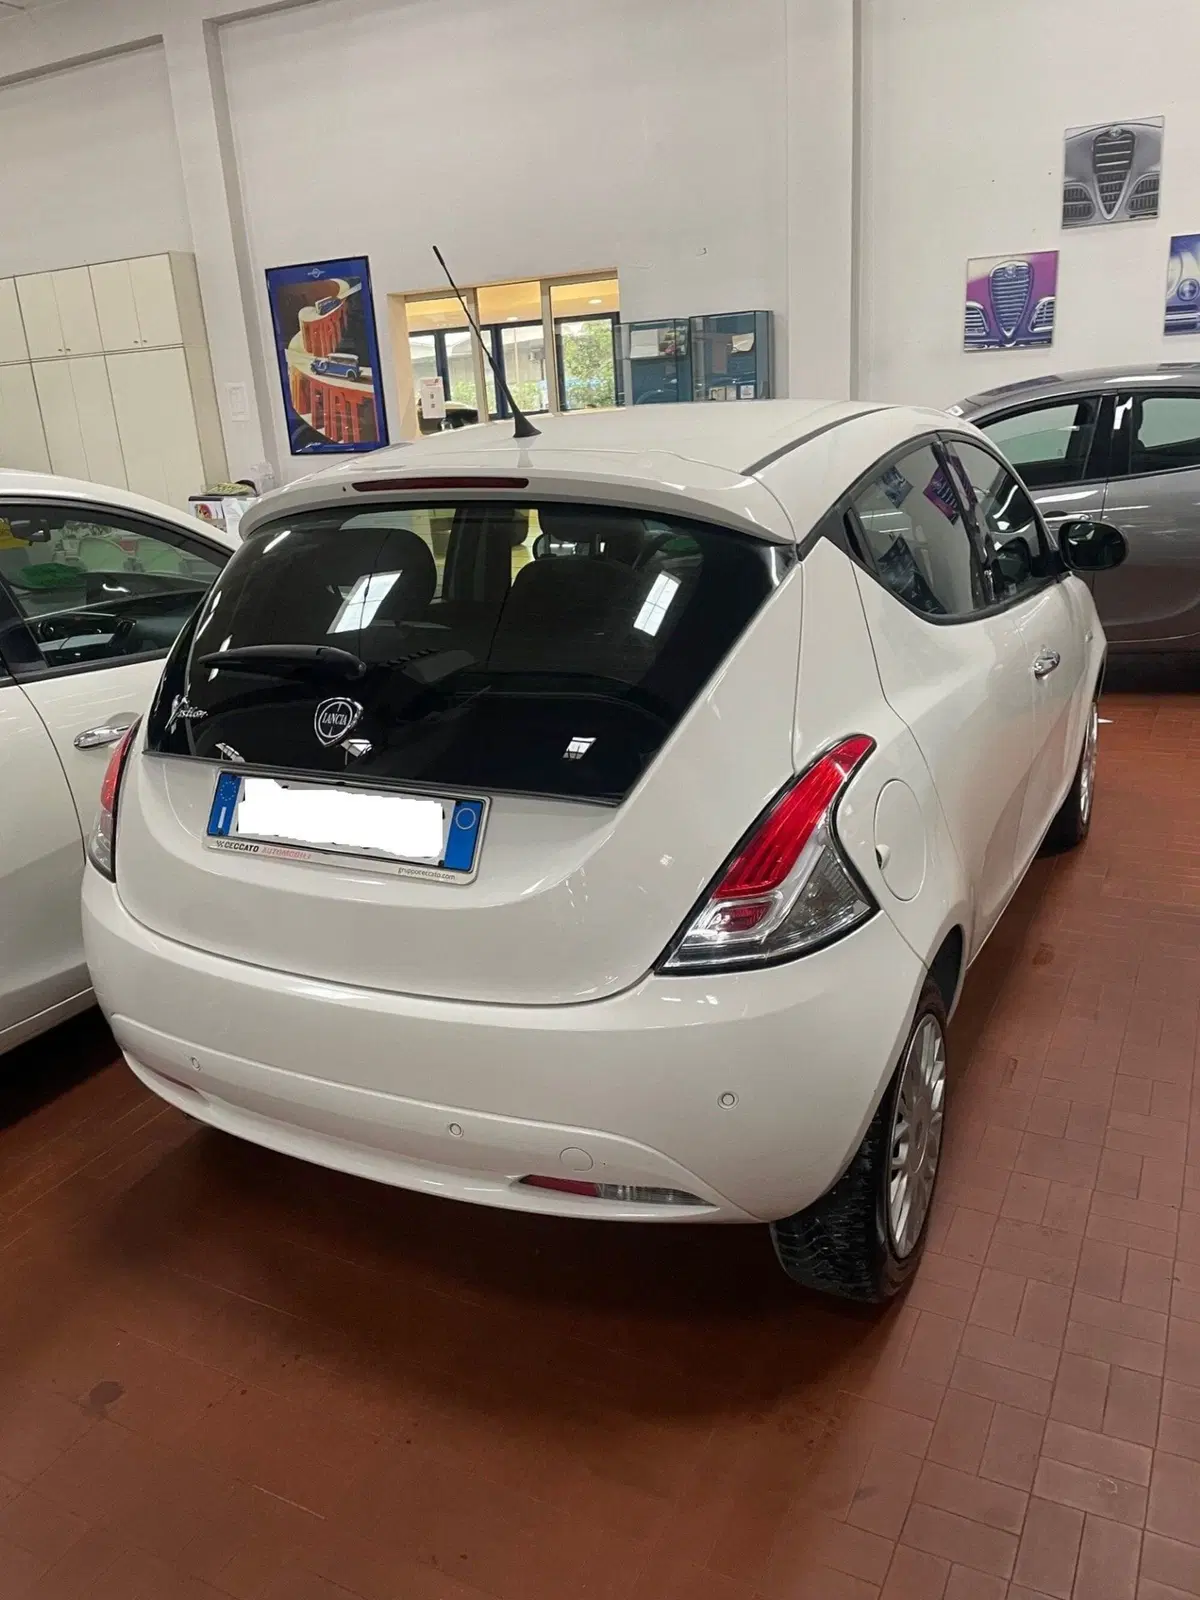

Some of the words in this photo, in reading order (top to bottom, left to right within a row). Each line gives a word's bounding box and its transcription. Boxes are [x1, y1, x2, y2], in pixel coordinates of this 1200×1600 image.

[322, 712, 347, 726] LANCIA
[224, 840, 259, 853] CECCATO
[397, 867, 456, 880] gruppoceccato.com
